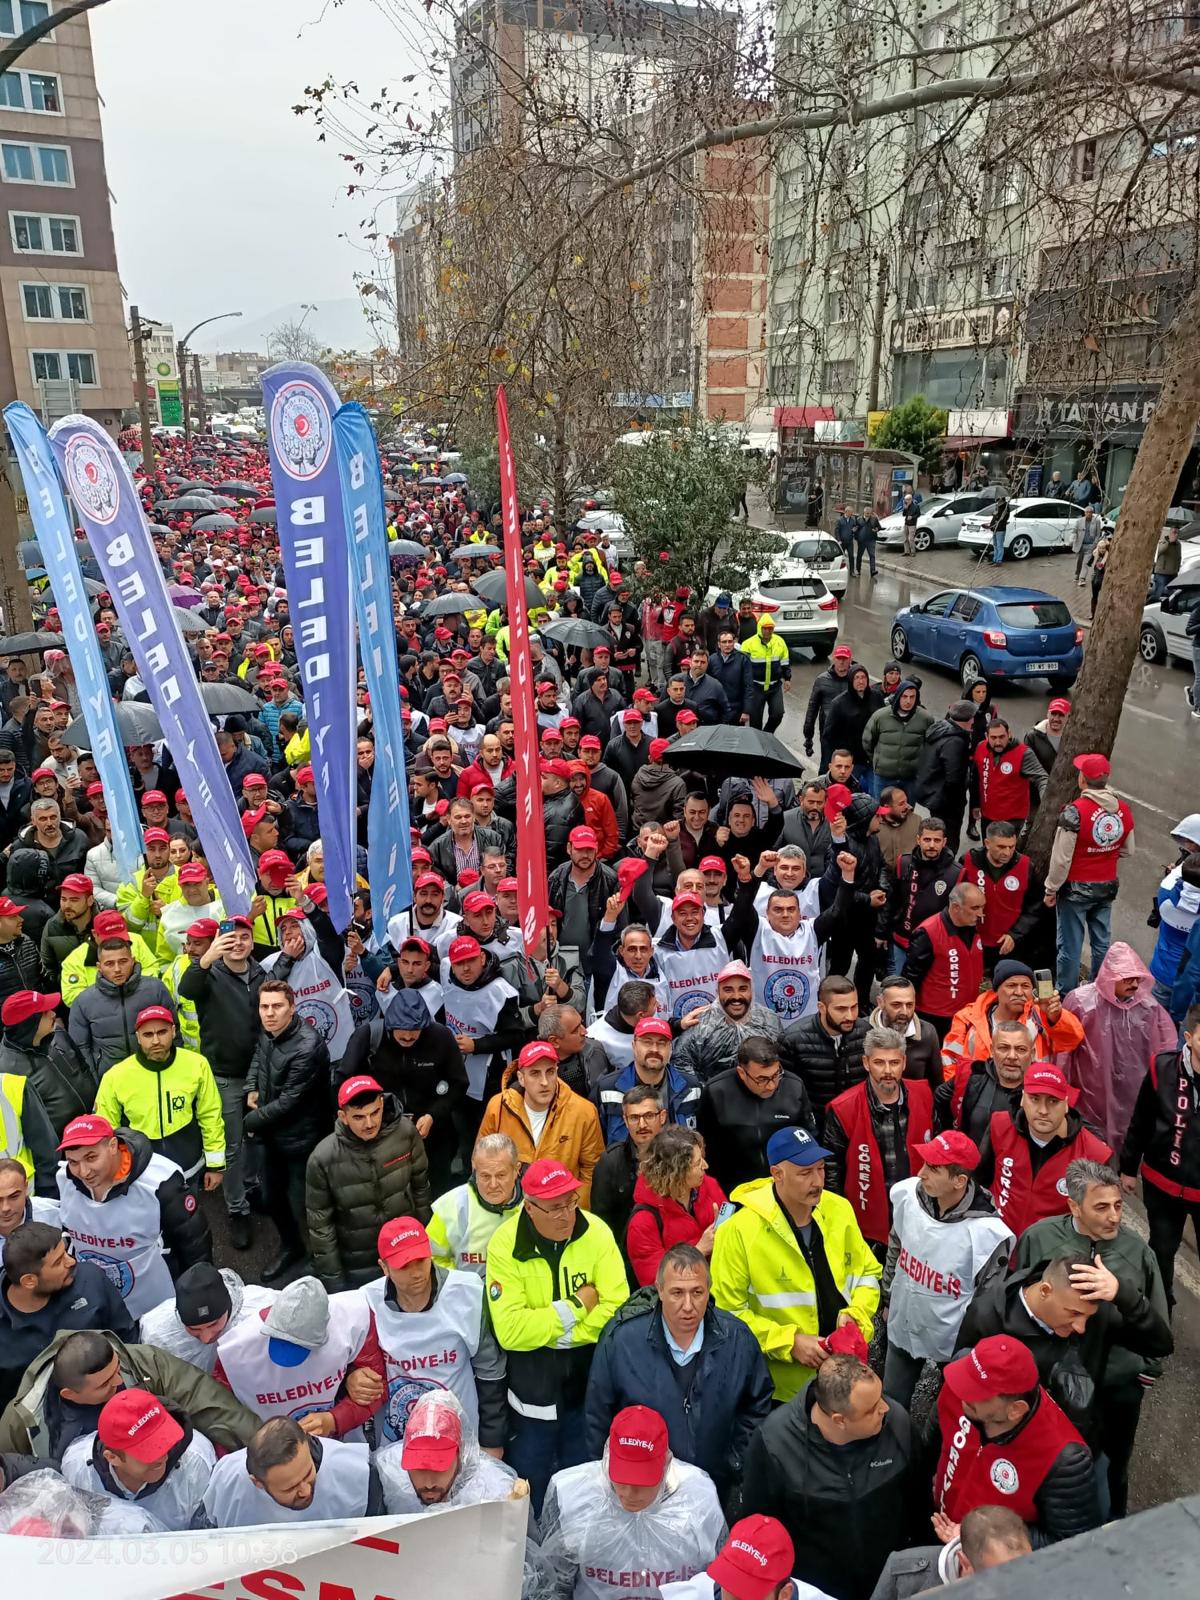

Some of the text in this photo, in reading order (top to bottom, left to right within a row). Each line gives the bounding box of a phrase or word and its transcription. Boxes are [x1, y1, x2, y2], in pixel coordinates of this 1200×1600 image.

[1169, 1077, 1189, 1166] POLİS
[68, 1229, 137, 1249] ELEDİYE-İŞ
[461, 1252, 487, 1265] BEL
[898, 1247, 961, 1301] ELEDİYE-İŞ
[127, 1406, 161, 1437] BELEDİYE-İŞ
